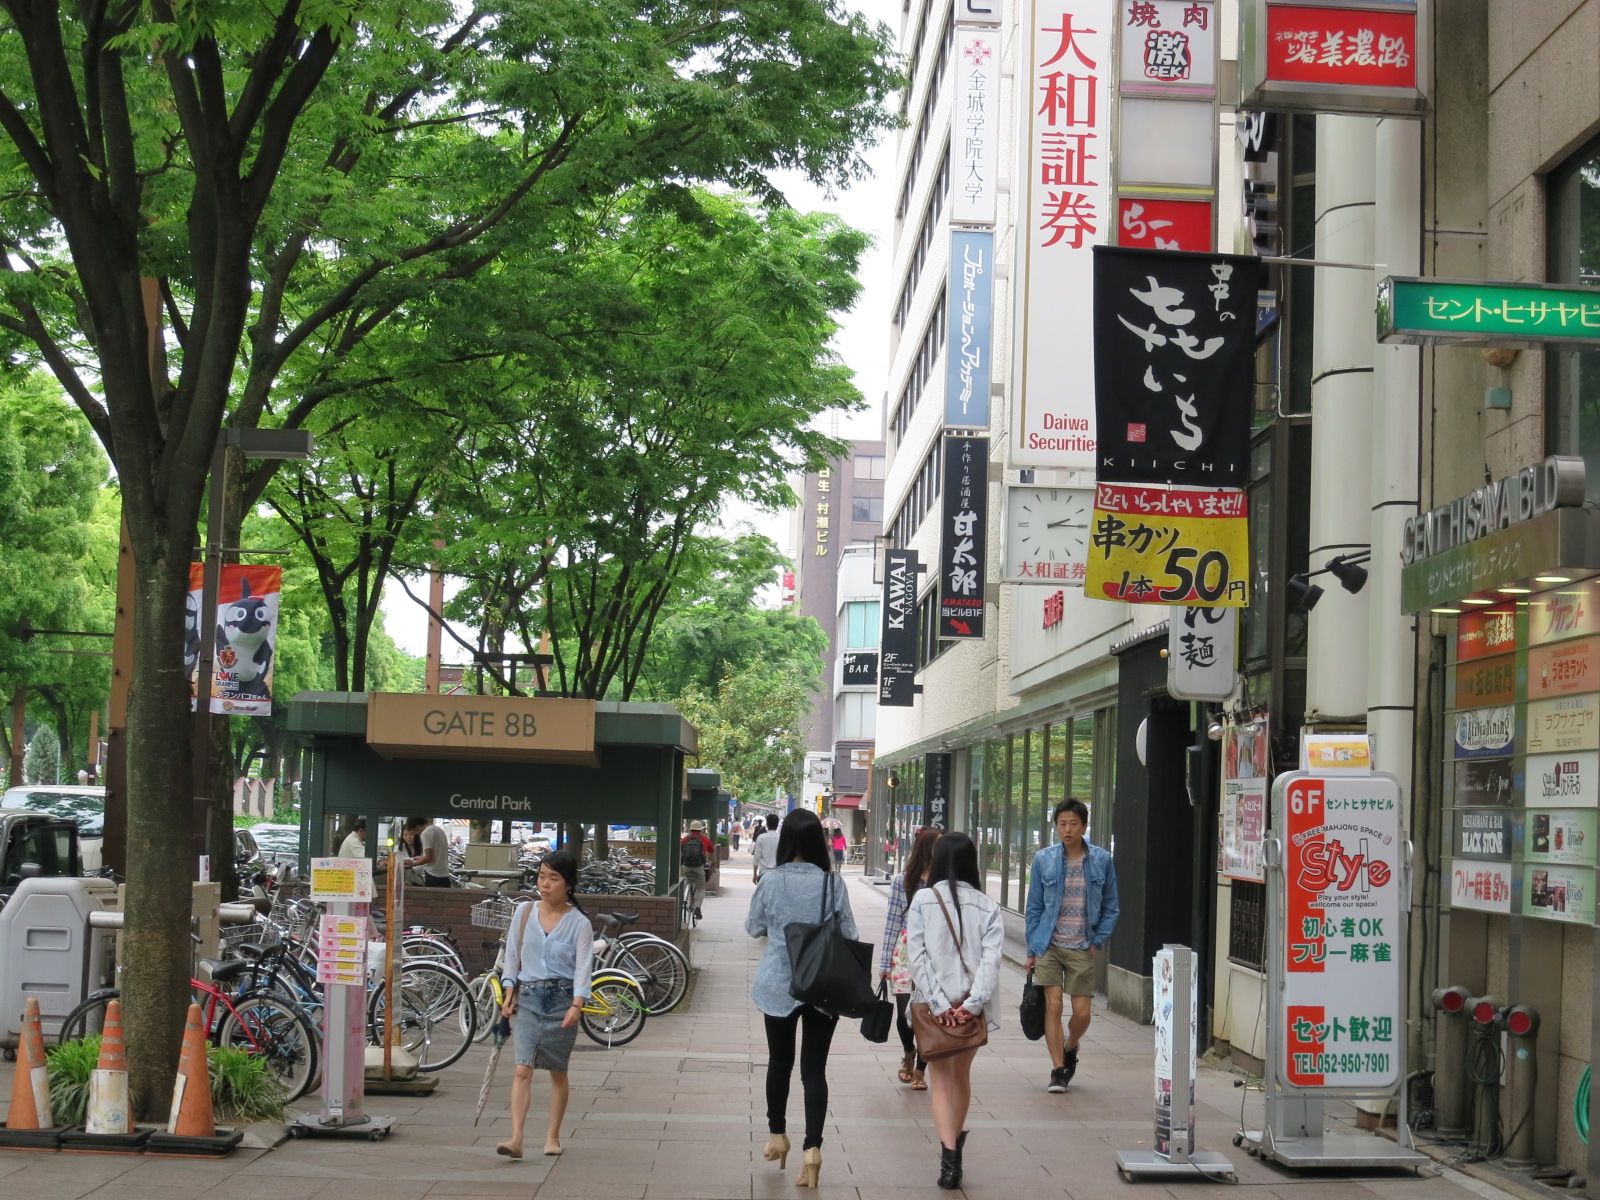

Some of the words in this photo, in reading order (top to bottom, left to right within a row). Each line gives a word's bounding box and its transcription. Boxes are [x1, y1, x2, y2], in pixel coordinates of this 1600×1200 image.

[1127, 2, 1208, 31] 焼肉
[1145, 31, 1190, 67] 激
[1145, 65, 1190, 80] GEKI
[964, 69, 987, 205] 金城学院大学
[1038, 13, 1098, 249] 大和証券
[1208, 260, 1236, 321] 串の
[1043, 413, 1089, 431] Daiwa
[1029, 432, 1098, 453] Securitie
[960, 441, 972, 509] 手作り居酒屋
[1103, 458, 1234, 472] KIICHI
[1402, 508, 1450, 566] CENT
[1450, 476, 1514, 548] HISAYA
[1519, 454, 1572, 520] BLD
[1093, 514, 1180, 561] 串カツ
[948, 511, 978, 596] 甘太郎
[1017, 561, 1086, 580] 大和証券
[1118, 571, 1154, 598] 1本
[1160, 548, 1245, 601] 50円
[888, 557, 907, 630] KAWAI
[905, 571, 914, 616] NAGOYA
[942, 607, 983, 617] 当ビルB1F
[849, 664, 869, 674] BAR
[884, 653, 899, 663] 2F
[883, 677, 897, 686] 1F
[424, 710, 495, 736] GATE
[505, 712, 537, 738] 8B
[450, 793, 498, 810] Central
[502, 795, 532, 811] Park
[1290, 789, 1321, 814] 6F
[1326, 799, 1394, 811] セントヒサヤビル
[1359, 826, 1384, 839] SPACE
[1462, 832, 1482, 853] BLACK
[1483, 832, 1503, 853] STONE
[1297, 838, 1391, 893] Style
[1318, 894, 1333, 902] Play
[1334, 895, 1349, 903] your
[1303, 917, 1384, 940] 初心者OK
[1292, 943, 1392, 963] フリー麻雀
[1293, 1017, 1392, 1043] セット歓迎
